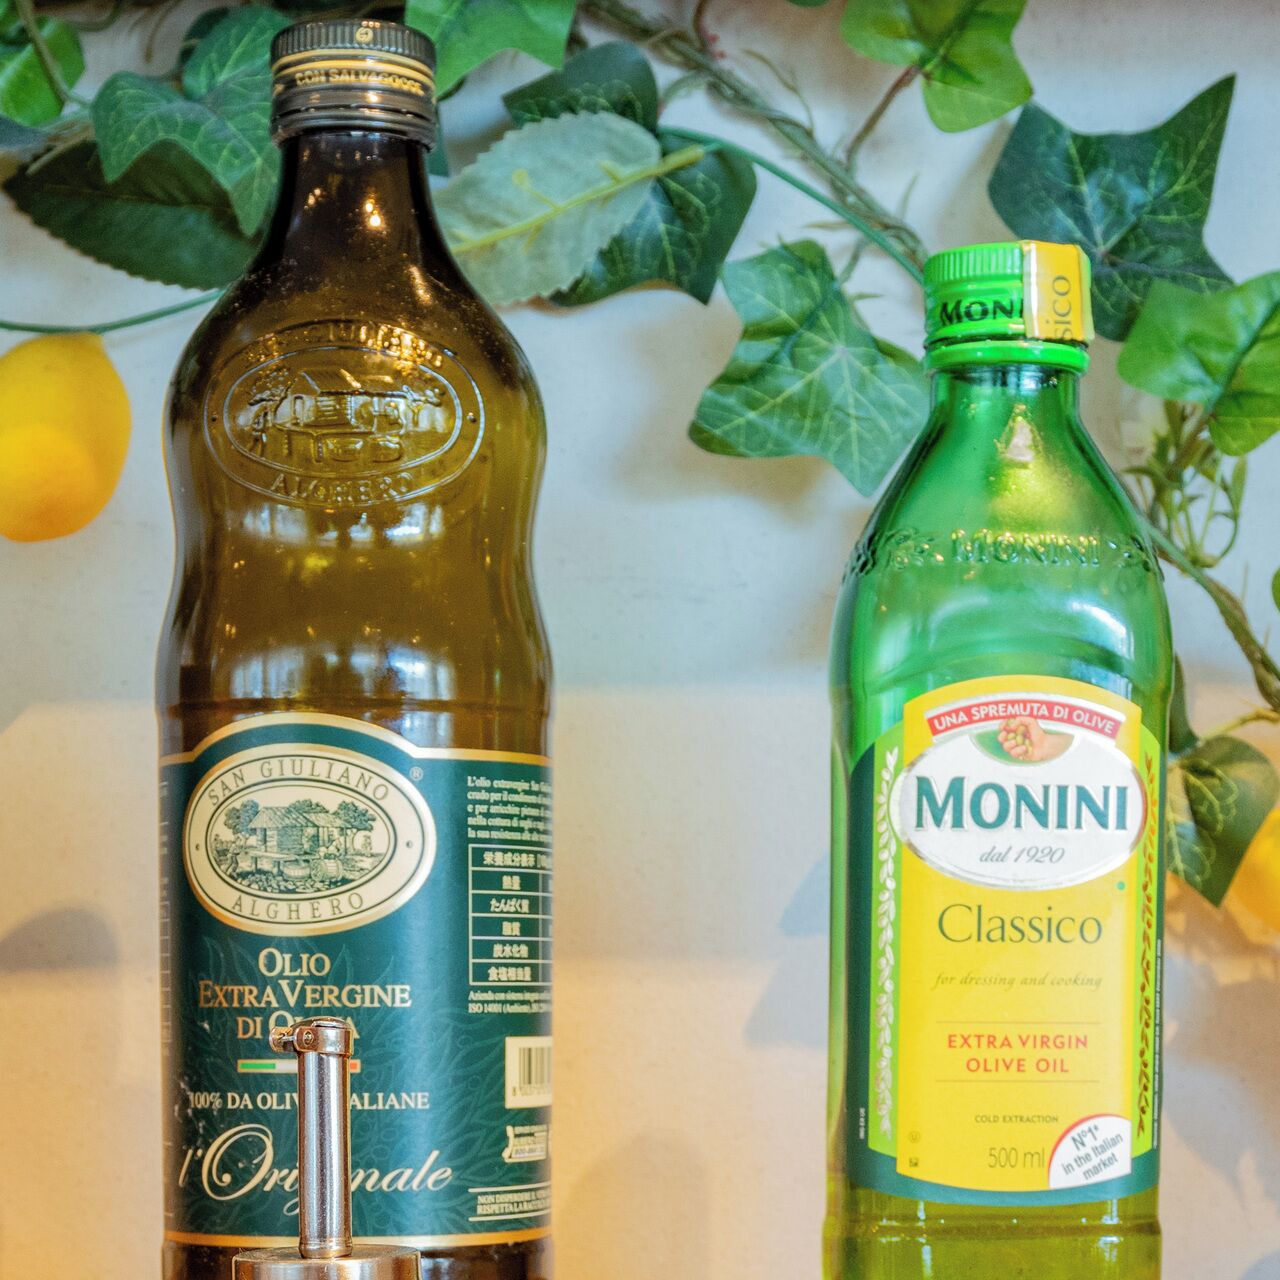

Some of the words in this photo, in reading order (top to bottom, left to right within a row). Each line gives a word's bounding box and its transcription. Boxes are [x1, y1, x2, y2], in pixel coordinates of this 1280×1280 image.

[934, 713, 969, 731] UNA
[971, 702, 1049, 720] SPREMUTA
[1053, 706, 1069, 719] DI
[1074, 709, 1115, 735] OLIVE
[208, 768, 246, 806] SAN
[260, 758, 389, 802] GIULIANO
[915, 776, 1128, 831] MONINI
[979, 845, 1008, 863] dal
[1013, 846, 1066, 863] 1920
[232, 892, 364, 920] ALGHERO
[938, 903, 1102, 944] Classico
[258, 947, 331, 977] OLIO
[198, 980, 279, 1009] EXTRA
[277, 979, 412, 1009] VERGINE
[933, 972, 956, 992] for
[960, 971, 1015, 989] dressing
[1020, 971, 1047, 986] and
[1050, 972, 1103, 990] cooking
[237, 1016, 262, 1039] DI
[947, 1034, 1013, 1050] EXTRA
[1019, 1034, 1089, 1050] VIRGIN
[965, 1058, 1027, 1073] OLIVE
[1036, 1058, 1070, 1073] OIL
[189, 1091, 223, 1110] 100%
[227, 1092, 254, 1110] DA
[257, 1092, 299, 1110] OLIV
[349, 1091, 431, 1110] ALIANE
[975, 1114, 1000, 1124] COLD
[1002, 1114, 1059, 1124] EXTRACTION
[988, 1148, 1019, 1168] 500
[1023, 1148, 1045, 1168] ml
[1062, 1162, 1075, 1175] in
[1077, 1151, 1093, 1168] the
[1091, 1133, 1123, 1158] Italian
[1082, 1152, 1118, 1180] market
